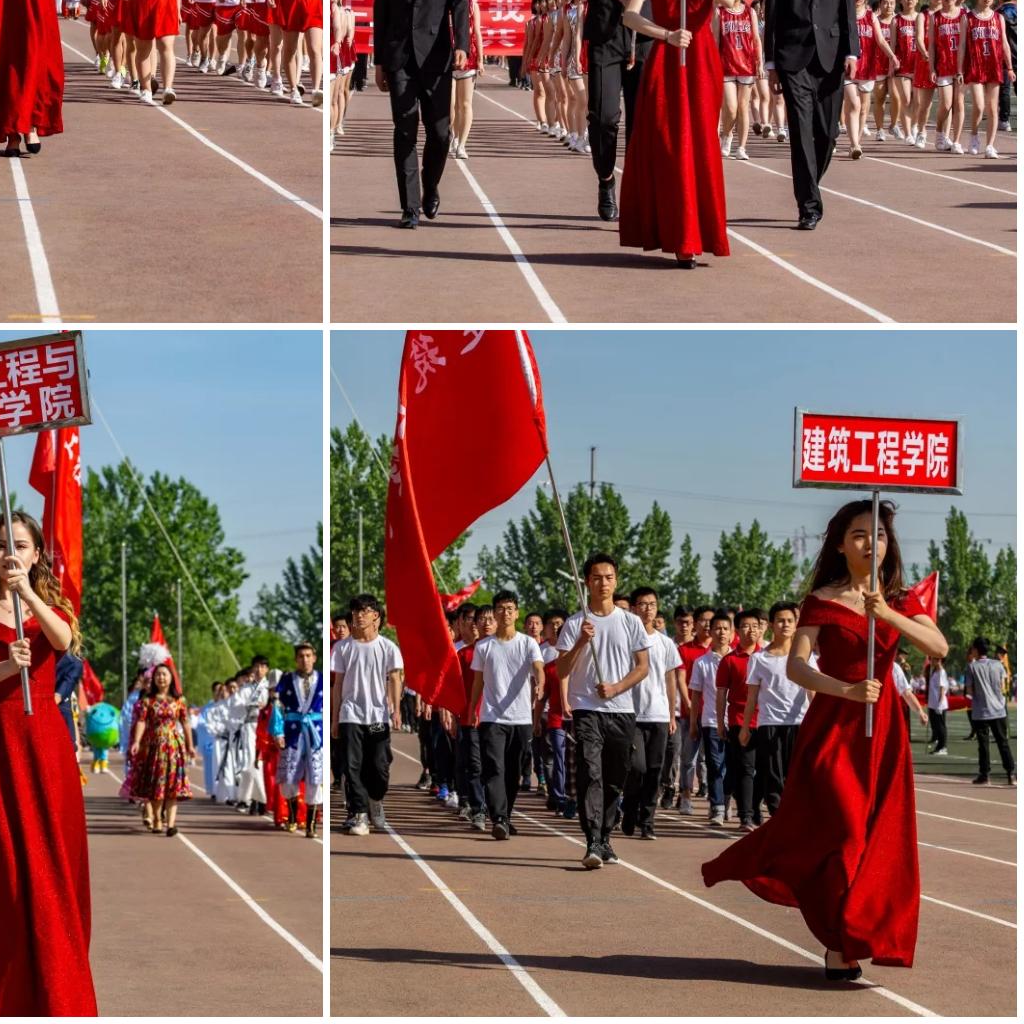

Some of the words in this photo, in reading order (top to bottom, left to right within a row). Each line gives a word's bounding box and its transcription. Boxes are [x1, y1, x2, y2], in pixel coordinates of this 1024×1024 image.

[949, 36, 958, 51] 1
[982, 41, 991, 56] 1
[801, 425, 950, 479] 建筑工程学院
